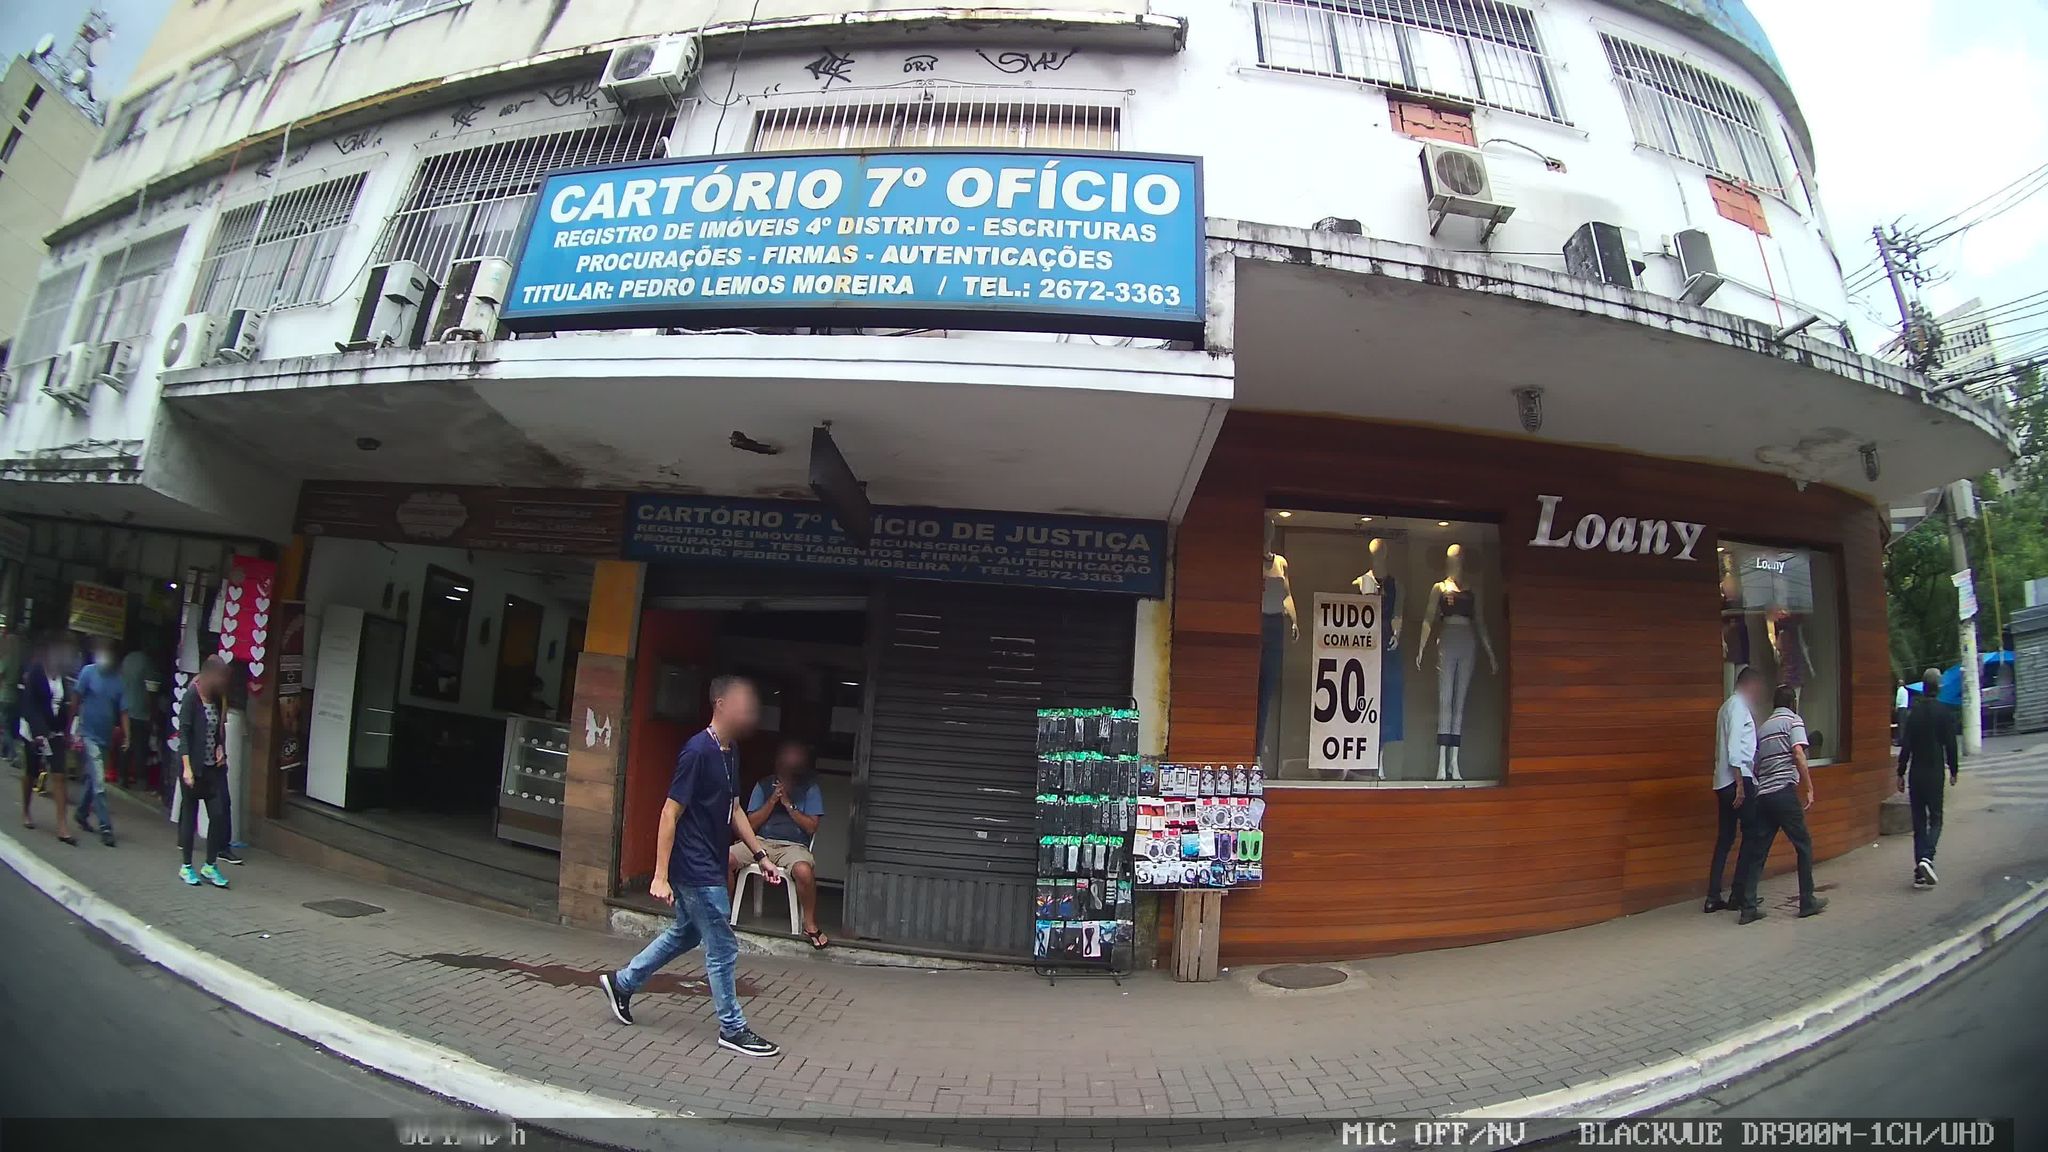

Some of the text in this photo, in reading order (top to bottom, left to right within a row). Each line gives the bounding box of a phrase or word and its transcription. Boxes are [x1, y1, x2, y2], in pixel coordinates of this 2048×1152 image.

[550, 160, 1181, 224] CARTÓRIO 7º OFÍCIO
[554, 223, 658, 248] REGISTRO
[663, 222, 694, 242] DE
[699, 216, 799, 239] IMÓVEIS
[805, 216, 832, 236] 4º
[837, 216, 960, 236] DISTRITO
[983, 217, 1157, 243] ESCRITURAS
[575, 245, 742, 274] PROCURAÇÕES
[762, 245, 859, 265] FIRMAS
[880, 244, 1113, 272] AUTENTICAÇÕES
[522, 274, 1181, 306] TITULAR: PEDRO LEMOS MOREIRA / TEL.: 2672-3363
[637, 523, 718, 538] REGISTRO
[722, 530, 745, 539] DE
[1025, 547, 1149, 564] ESCRITURAS
[638, 504, 784, 529] CARTÓRIO
[793, 512, 823, 530] 7º
[831, 512, 941, 539] ÍCIO
[951, 521, 996, 542] DE
[1005, 525, 1151, 552] JUSTIÇA
[1527, 494, 1706, 561] Loany
[633, 532, 754, 549] PROCURAÇÕES
[770, 542, 903, 559] TESTAMENTOS
[920, 551, 980, 564] FIRMA
[998, 556, 1152, 576] AUTENTICAÇÃO
[654, 543, 726, 558] TITULAR:
[732, 549, 791, 562] PEDRO
[795, 554, 858, 566] LEMOS
[864, 558, 950, 573] MOREIRA
[980, 565, 1020, 576] TEL:
[1025, 568, 1124, 583] 2672-3363
[1320, 603, 1375, 629] TUDO
[1323, 631, 1372, 648] COM ATÉ
[1314, 658, 1377, 724] 50%
[1322, 736, 1367, 760] OFF
